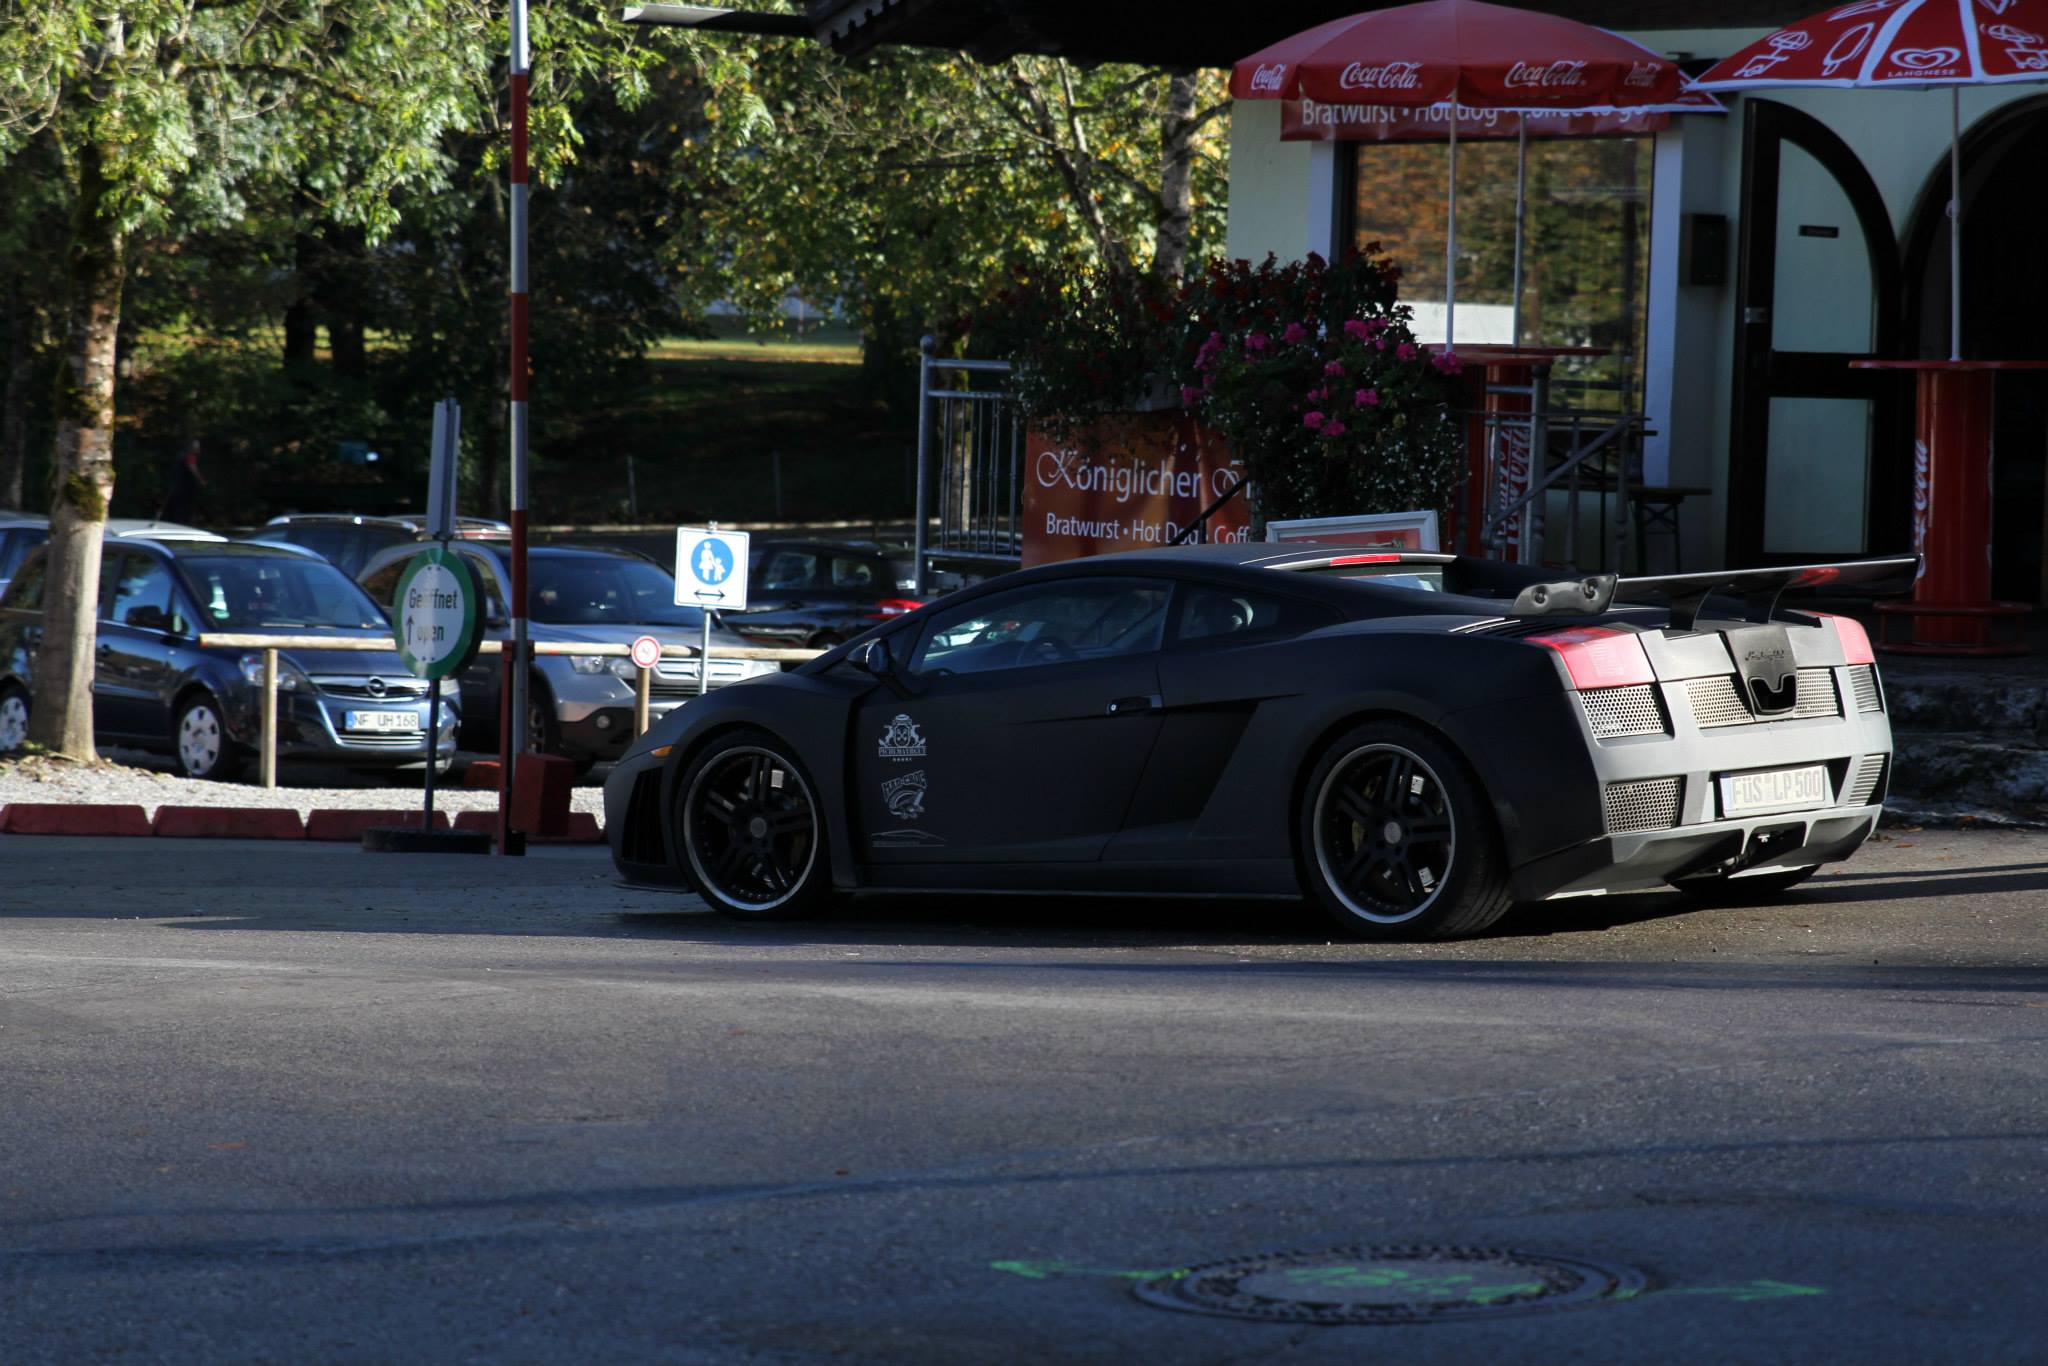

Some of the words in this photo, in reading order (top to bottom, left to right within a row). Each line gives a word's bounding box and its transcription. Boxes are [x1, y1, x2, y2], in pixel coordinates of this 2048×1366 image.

[1340, 62, 1424, 89] Coca-Cola
[1504, 60, 1588, 88] Coca-Cola
[1887, 68, 1957, 78] LANGNESE
[1302, 100, 1398, 125] Bratwurst
[1036, 449, 1202, 503] Königlicher
[1046, 512, 1120, 540] Bratwurst
[1132, 519, 1161, 543] Hot
